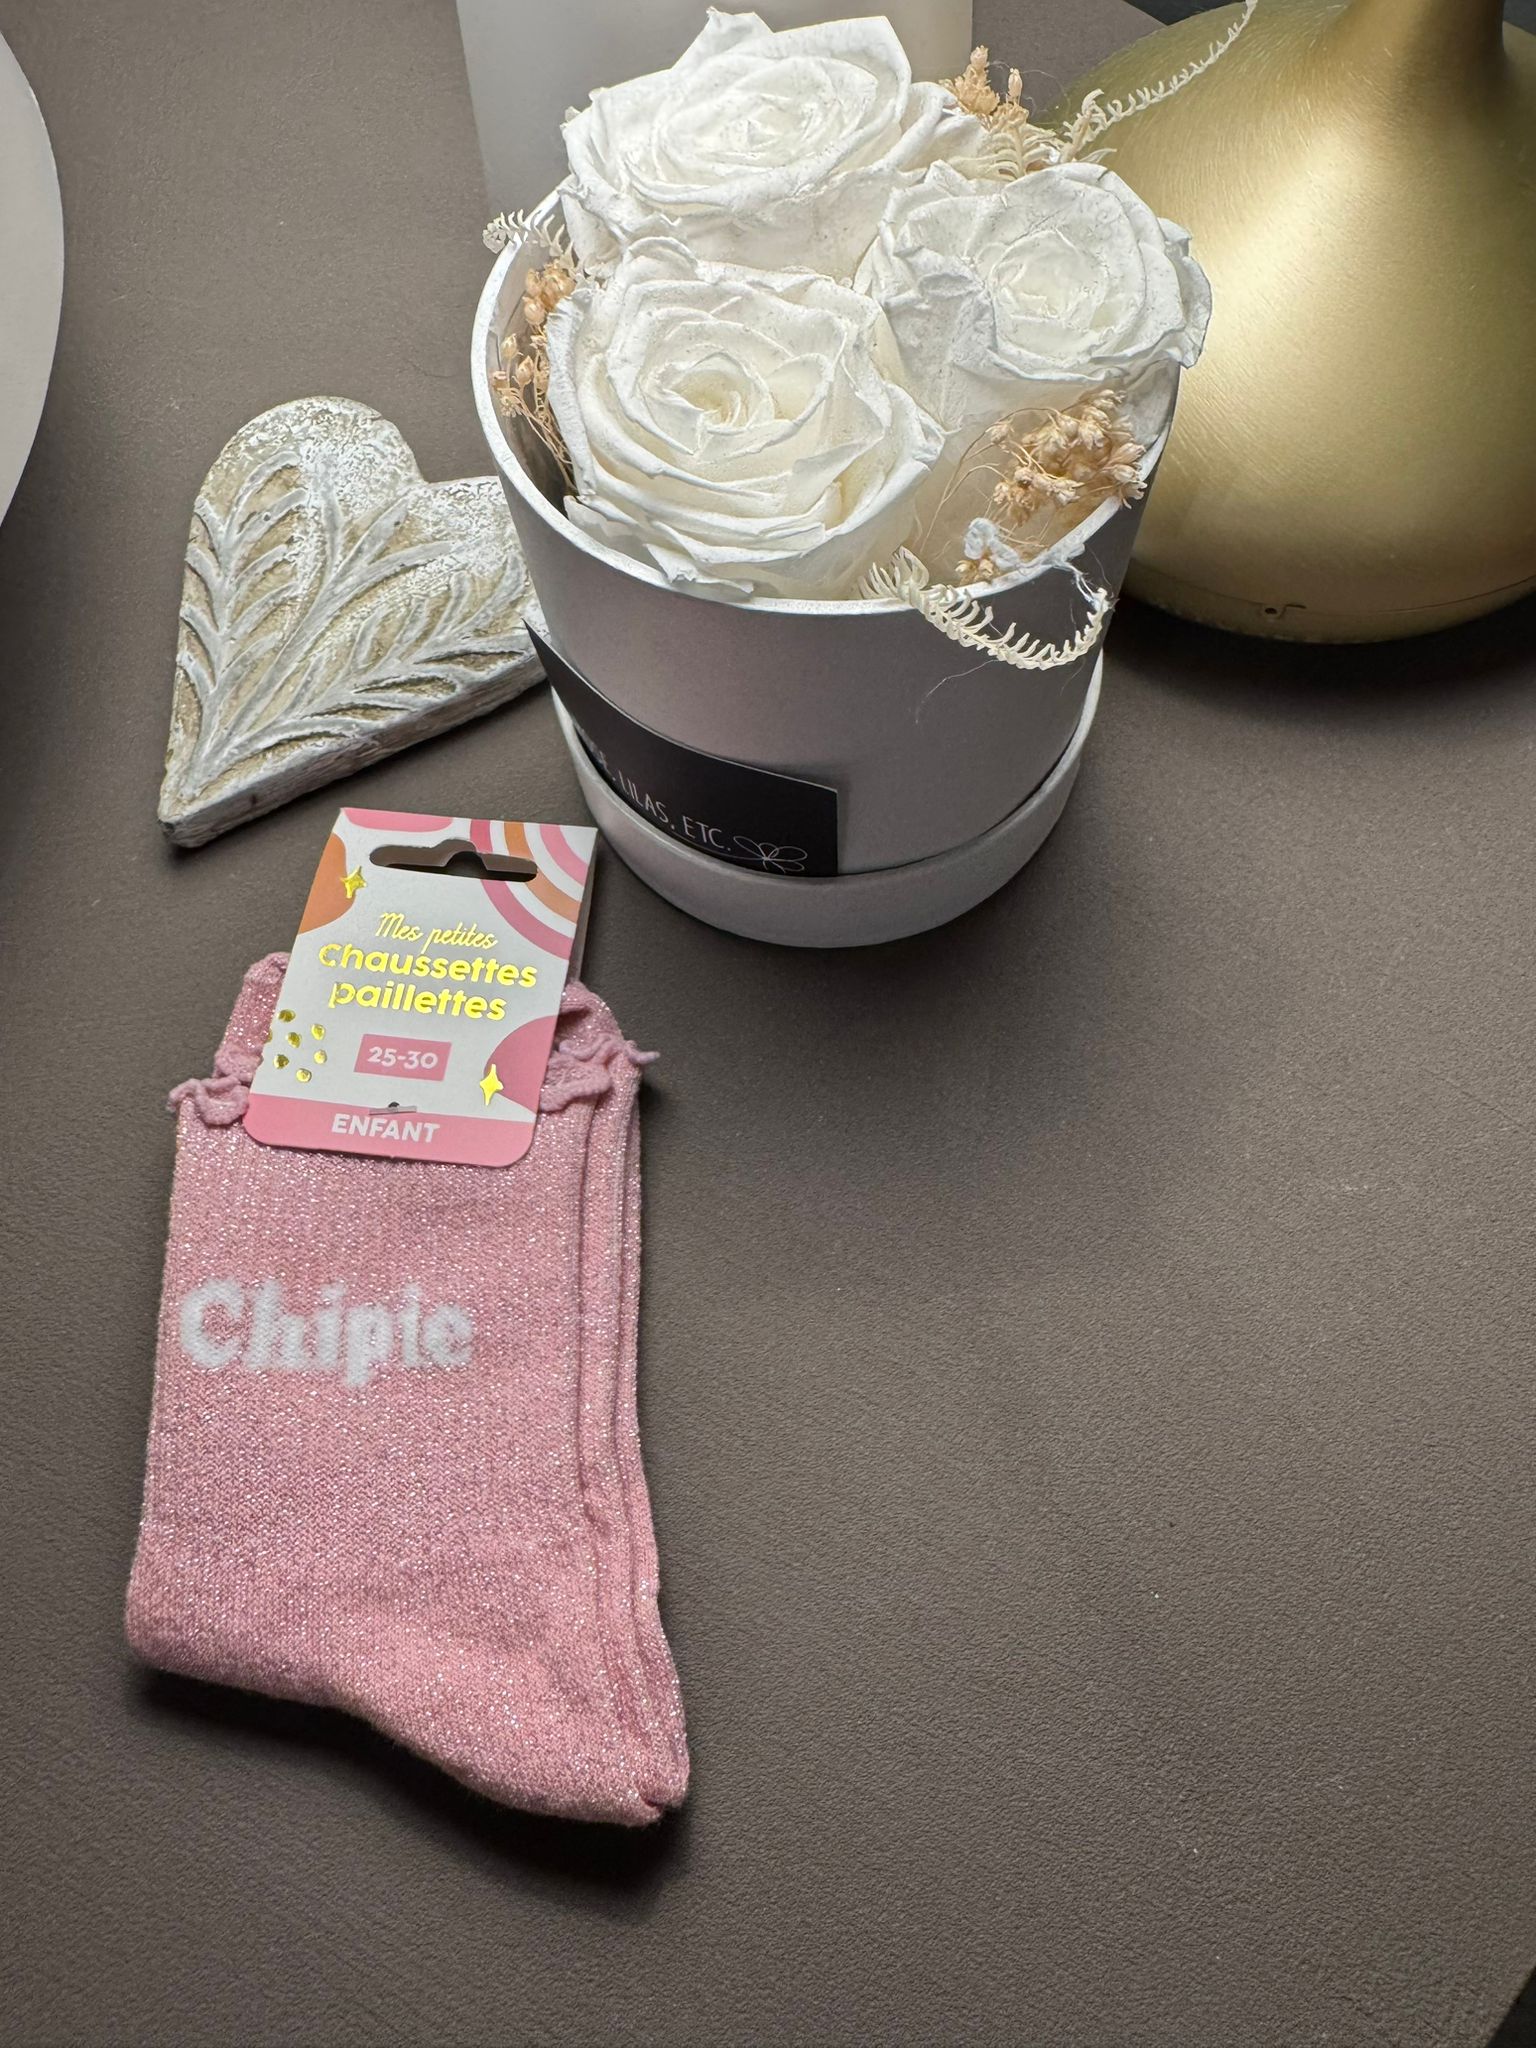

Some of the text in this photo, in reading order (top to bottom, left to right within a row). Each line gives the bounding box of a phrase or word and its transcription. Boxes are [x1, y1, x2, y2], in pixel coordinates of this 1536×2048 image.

[682, 815, 732, 851] ETC.
[375, 911, 498, 954] Mes petites
[328, 980, 507, 1021] paillettes
[366, 1046, 439, 1070] 25-30
[331, 1114, 440, 1143] ENFANT
[180, 1277, 474, 1387] Chipie
